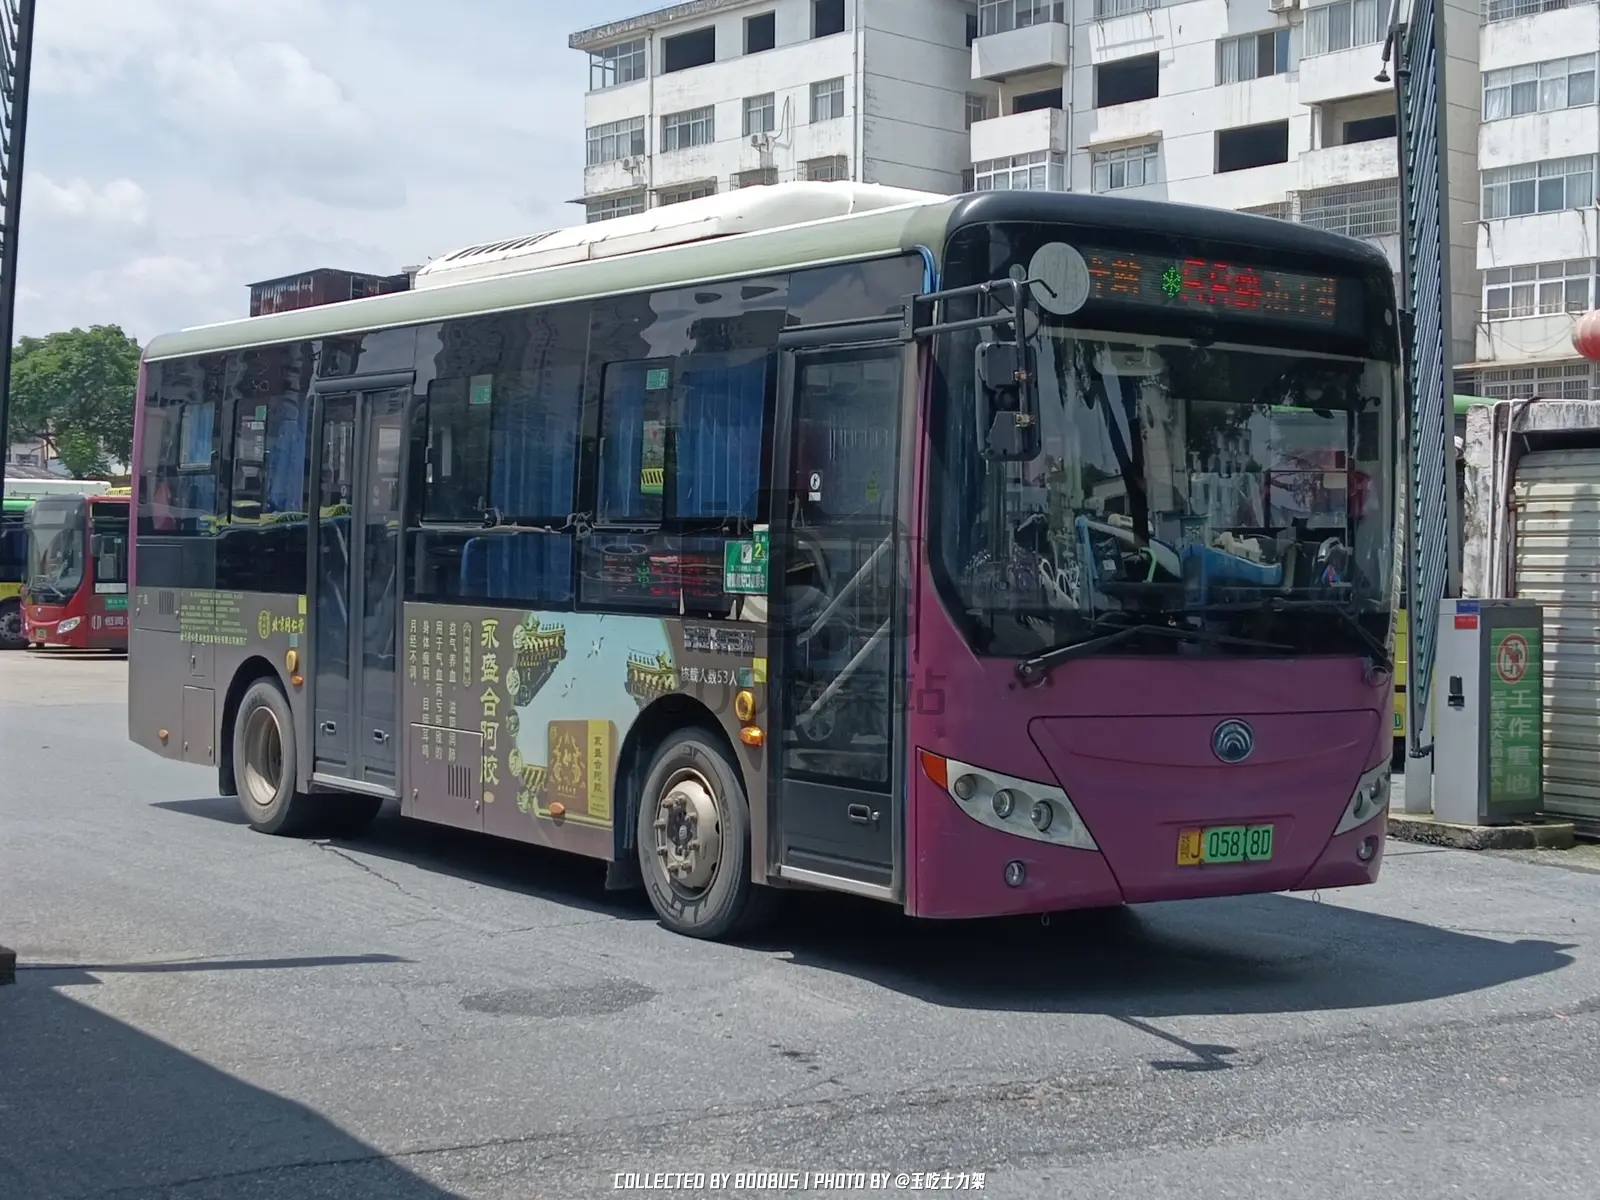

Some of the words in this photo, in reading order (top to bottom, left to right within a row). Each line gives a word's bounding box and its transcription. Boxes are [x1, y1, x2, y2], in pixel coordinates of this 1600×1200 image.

[479, 619, 500, 786] 永盛合阿胶
[680, 665, 738, 687] 核载人数53人
